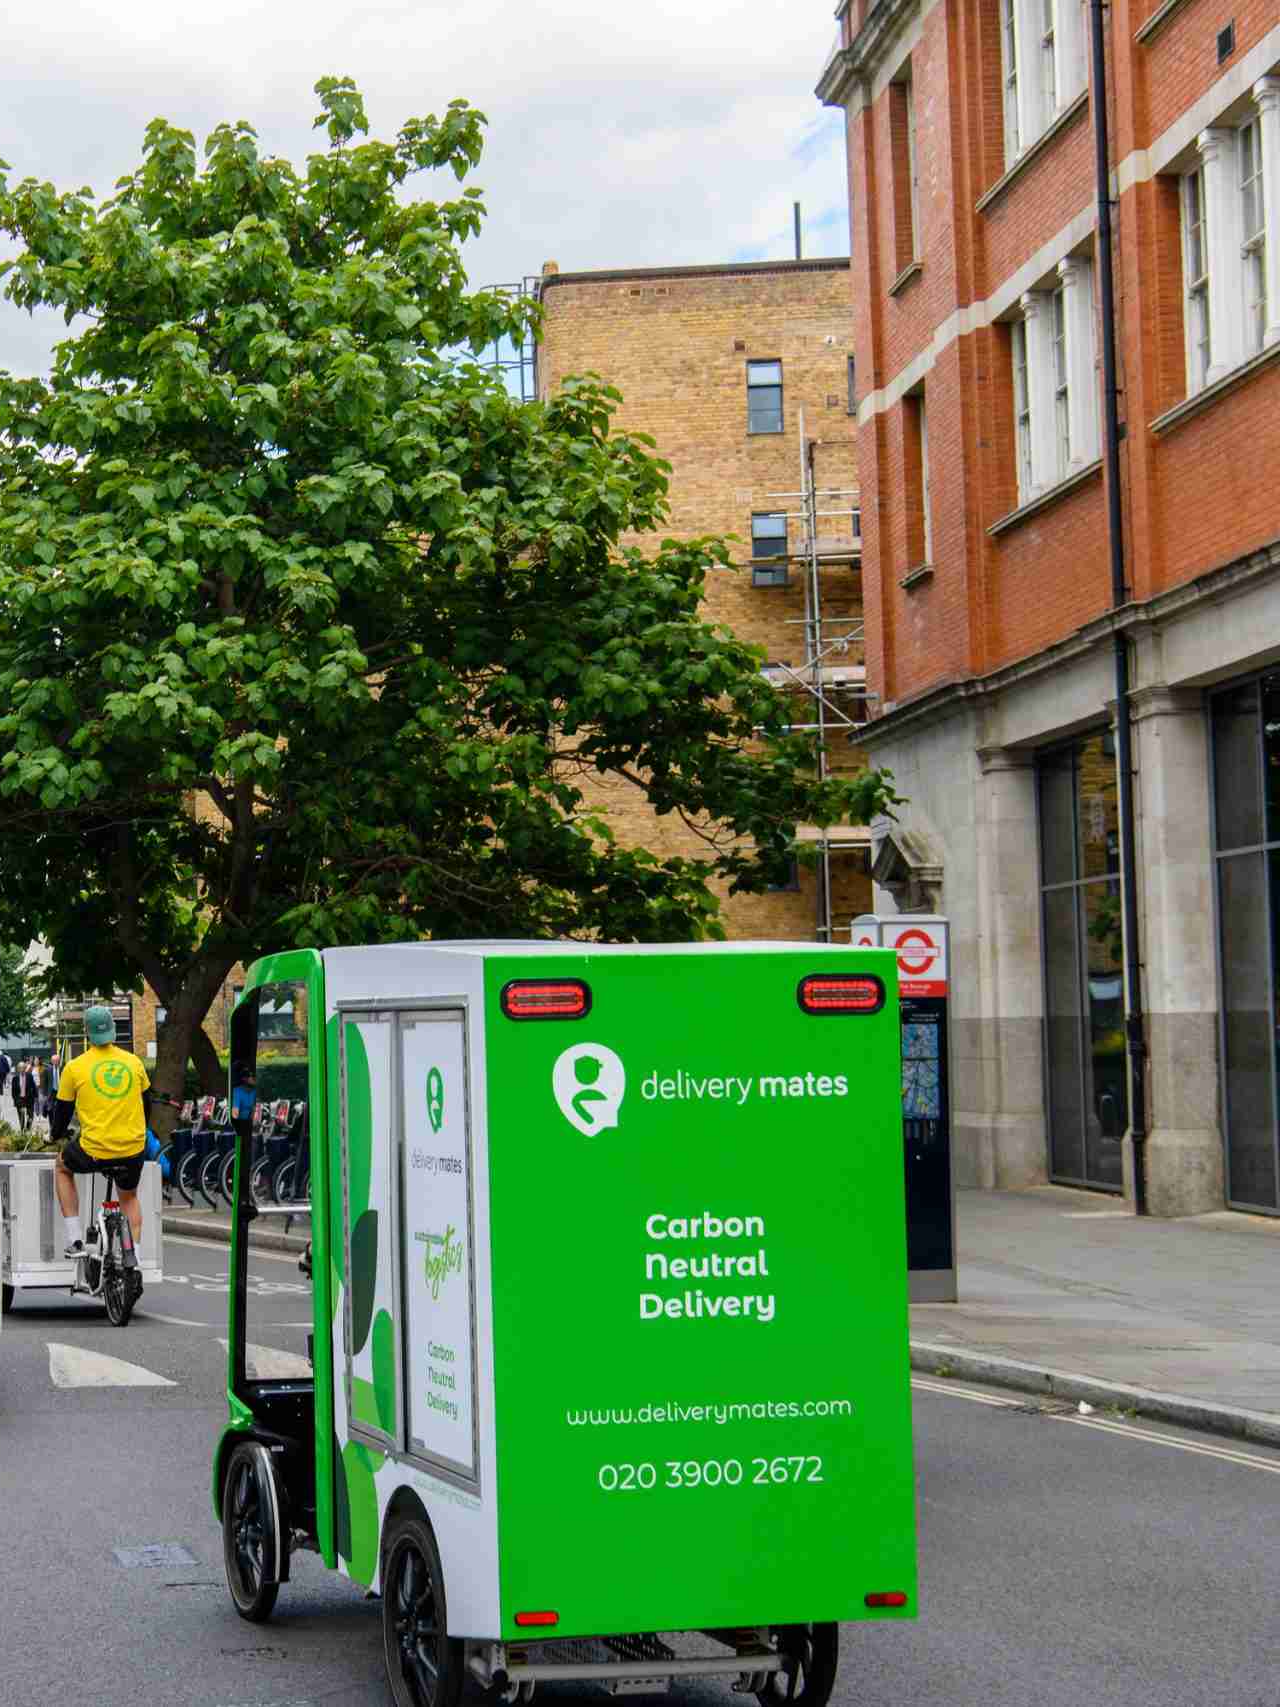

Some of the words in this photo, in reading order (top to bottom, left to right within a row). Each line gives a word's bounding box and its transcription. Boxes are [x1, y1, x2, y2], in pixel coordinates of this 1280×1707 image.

[641, 1069, 753, 1105] delivery
[759, 1071, 849, 1097] mates
[438, 1154, 463, 1175] mates
[645, 1211, 766, 1240] Carbon
[645, 1249, 769, 1280] Neutral
[639, 1289, 776, 1322] Delivery
[427, 1340, 455, 1363] Carbon
[428, 1366, 457, 1392] Neutral
[426, 1391, 459, 1421] Delivery
[566, 1399, 852, 1425] www.deliverymates.com
[598, 1463, 657, 1491] 020
[665, 1459, 743, 1488] 3900
[751, 1455, 824, 1484] 2672
